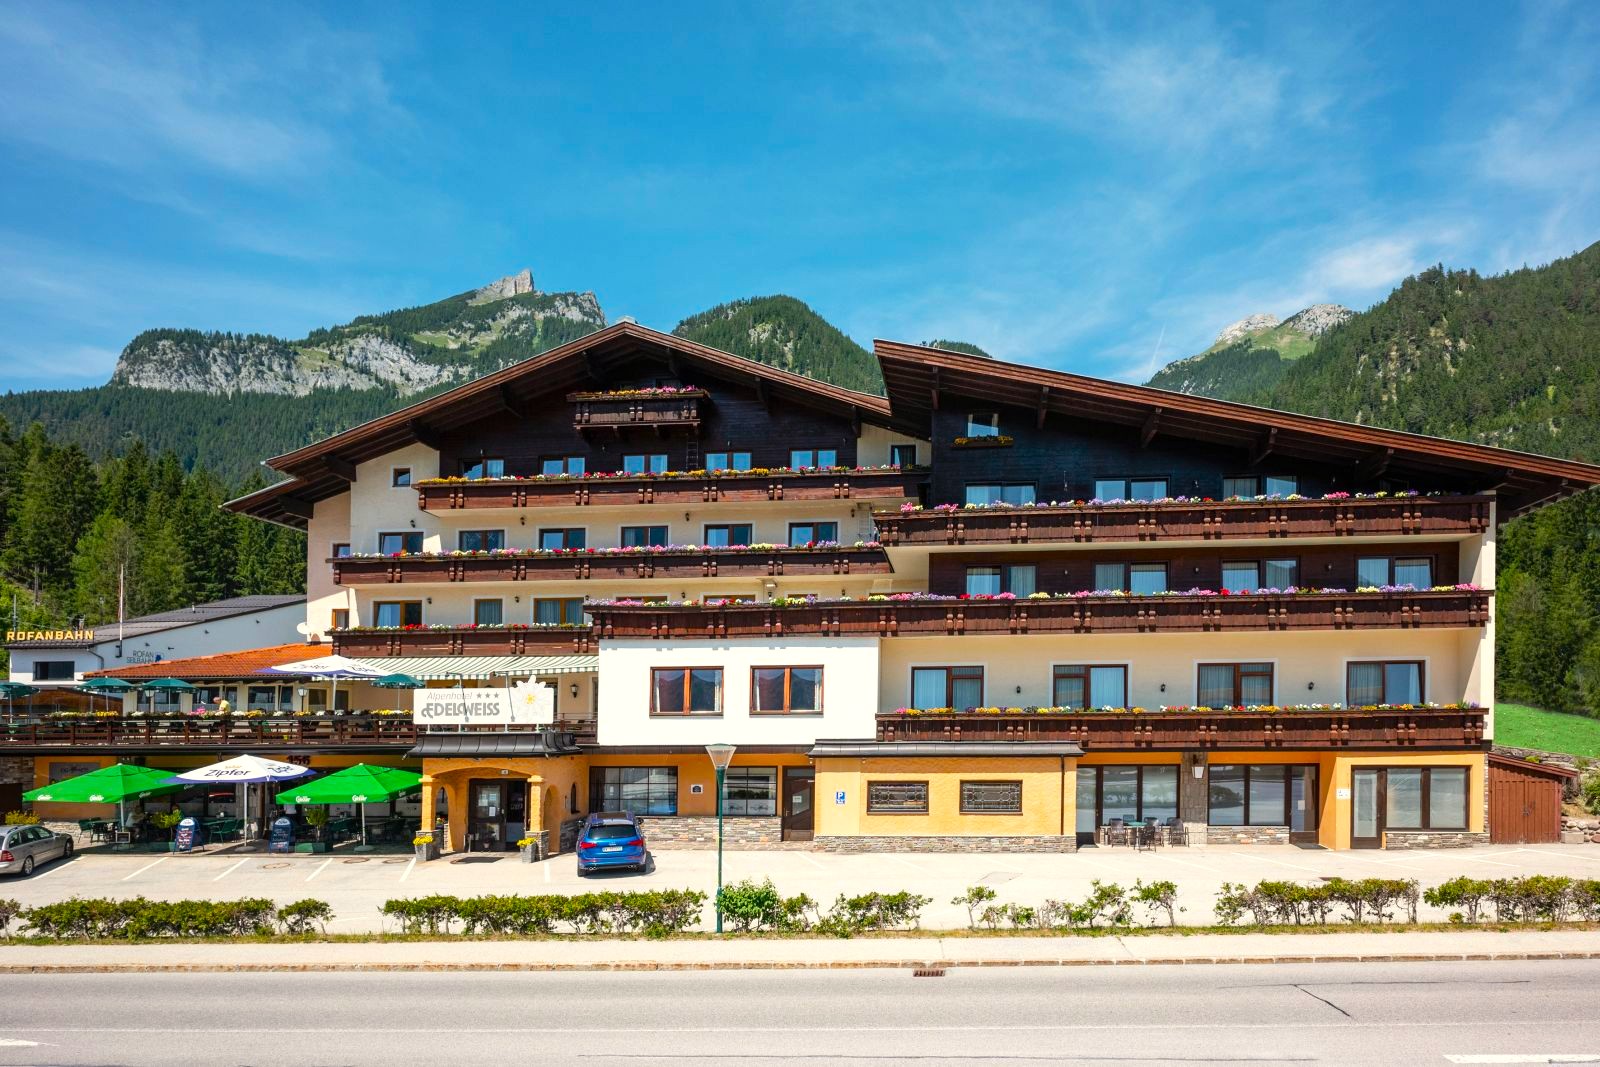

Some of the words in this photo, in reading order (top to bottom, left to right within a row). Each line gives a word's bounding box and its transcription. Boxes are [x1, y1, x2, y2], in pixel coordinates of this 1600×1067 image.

[6, 630, 94, 640] ROFANBAHN
[427, 691, 473, 701] Alpenhotel
[421, 702, 500, 719] EDELWEISS
[204, 769, 251, 777] Zipfer
